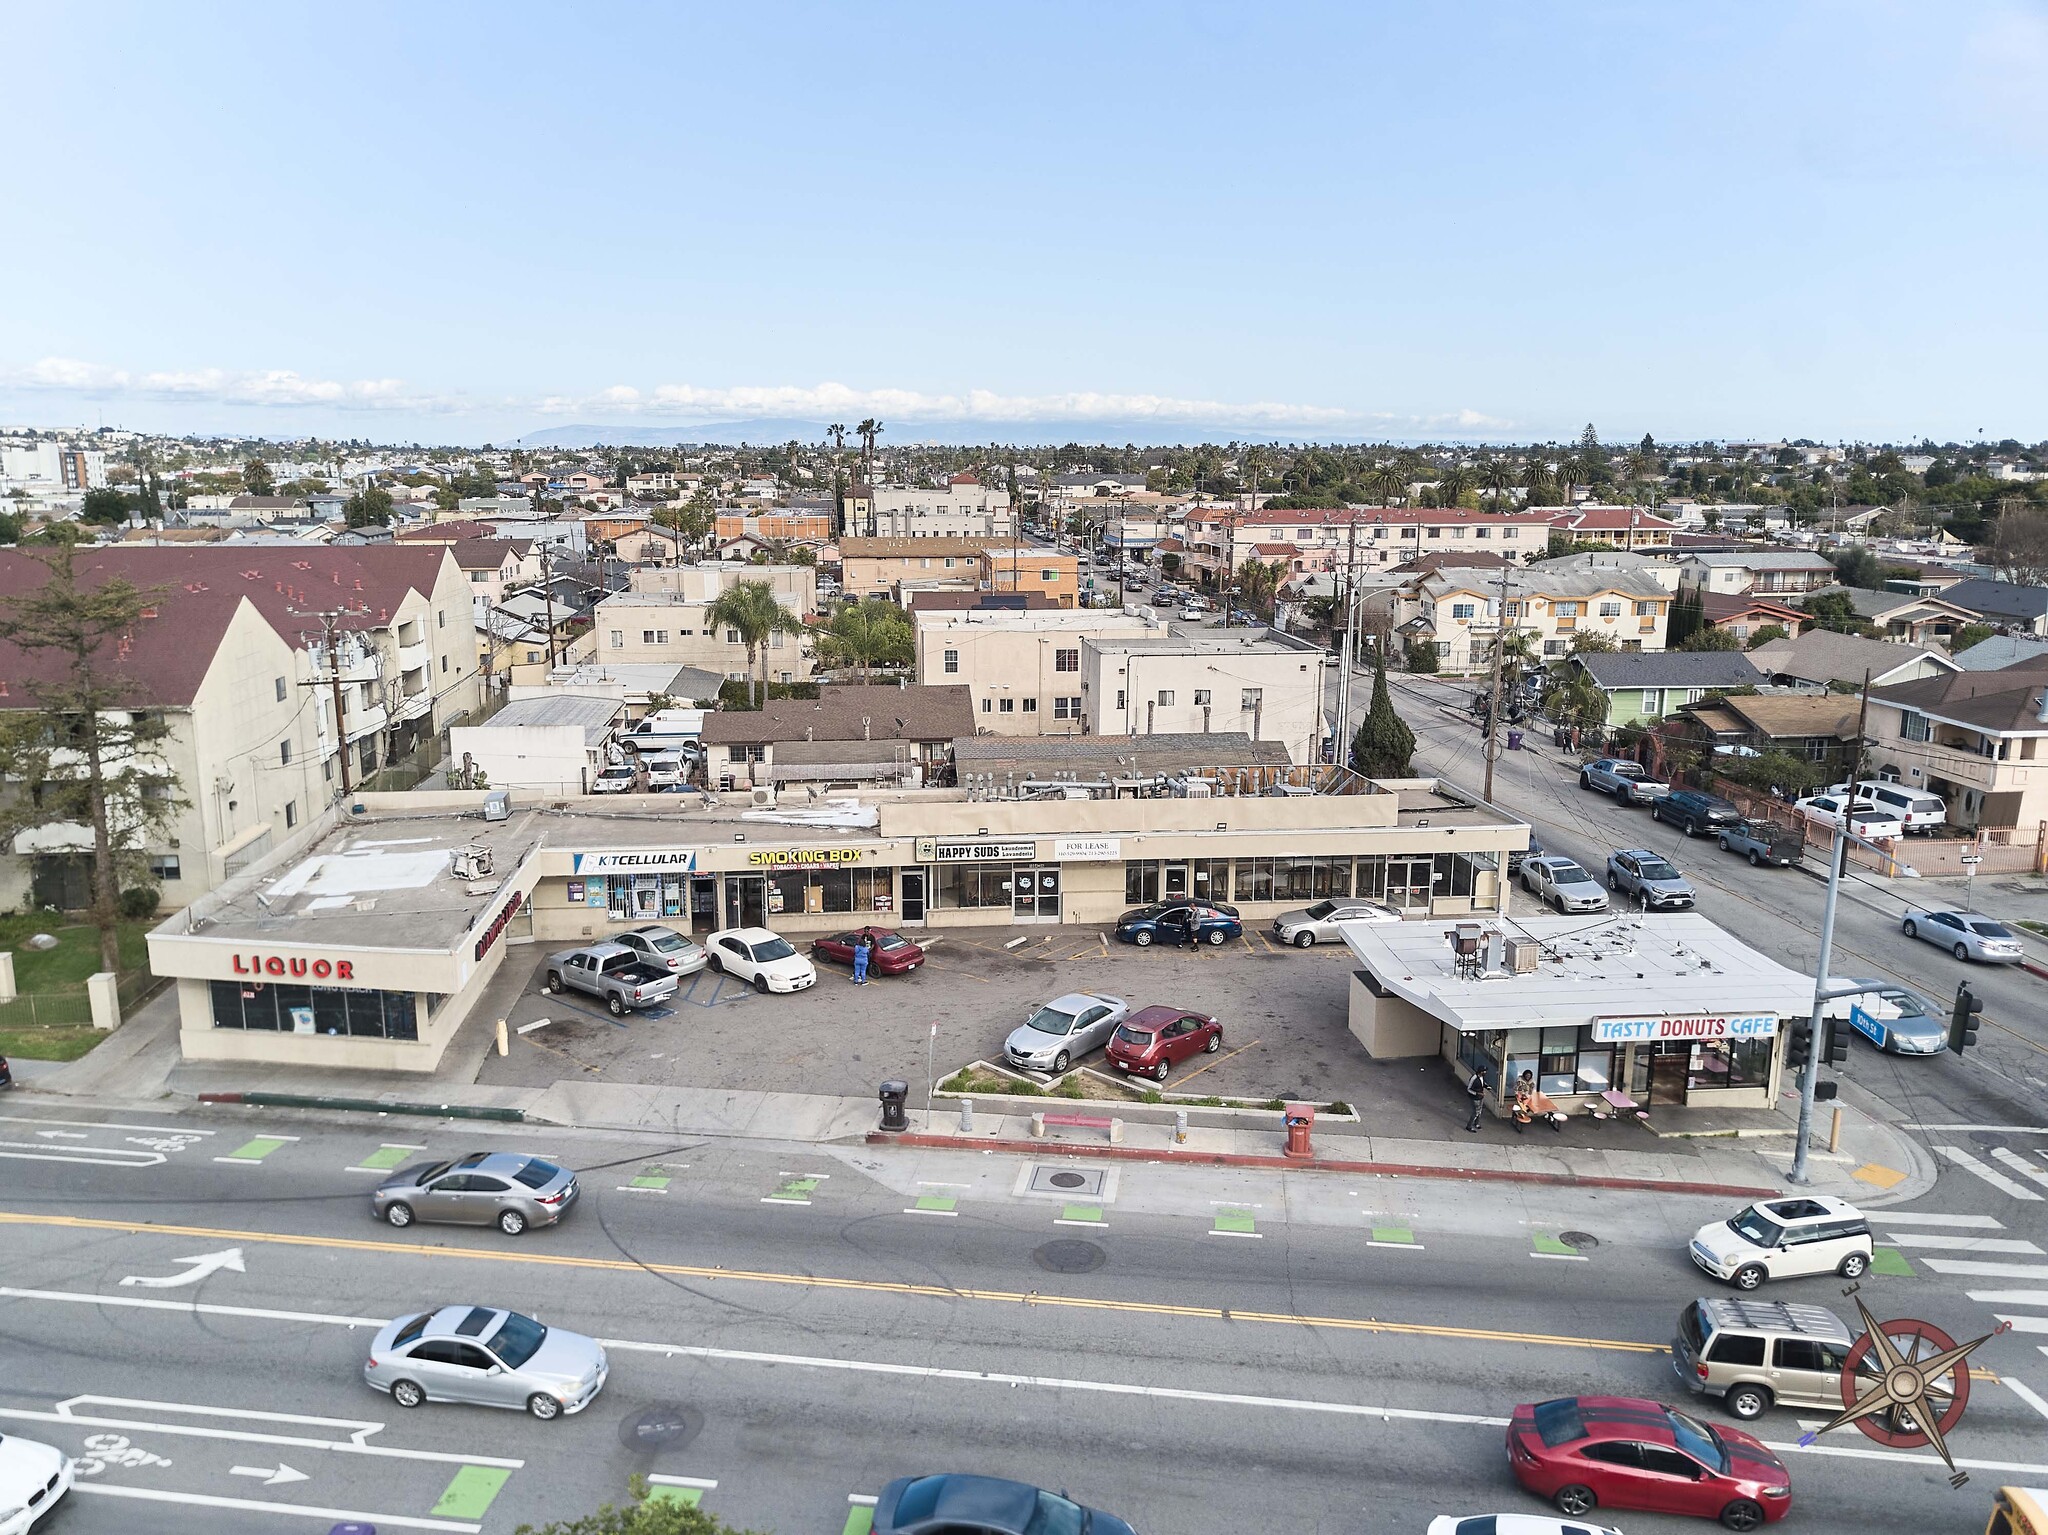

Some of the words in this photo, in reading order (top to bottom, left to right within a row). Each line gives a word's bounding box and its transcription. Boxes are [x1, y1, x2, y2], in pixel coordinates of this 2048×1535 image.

[939, 847, 971, 858] HAPPY
[975, 846, 999, 857] SUDS
[1085, 842, 1110, 850] LEASE
[749, 849, 827, 865] SMOKING
[829, 849, 862, 862] BOX
[232, 954, 355, 980] LIQUOR
[1601, 1021, 1657, 1039] TASTY
[1660, 1018, 1726, 1037] DONUTS
[1730, 1017, 1774, 1035] CAFE
[1857, 1013, 1870, 1031] 10th
[1869, 1023, 1877, 1036] St
